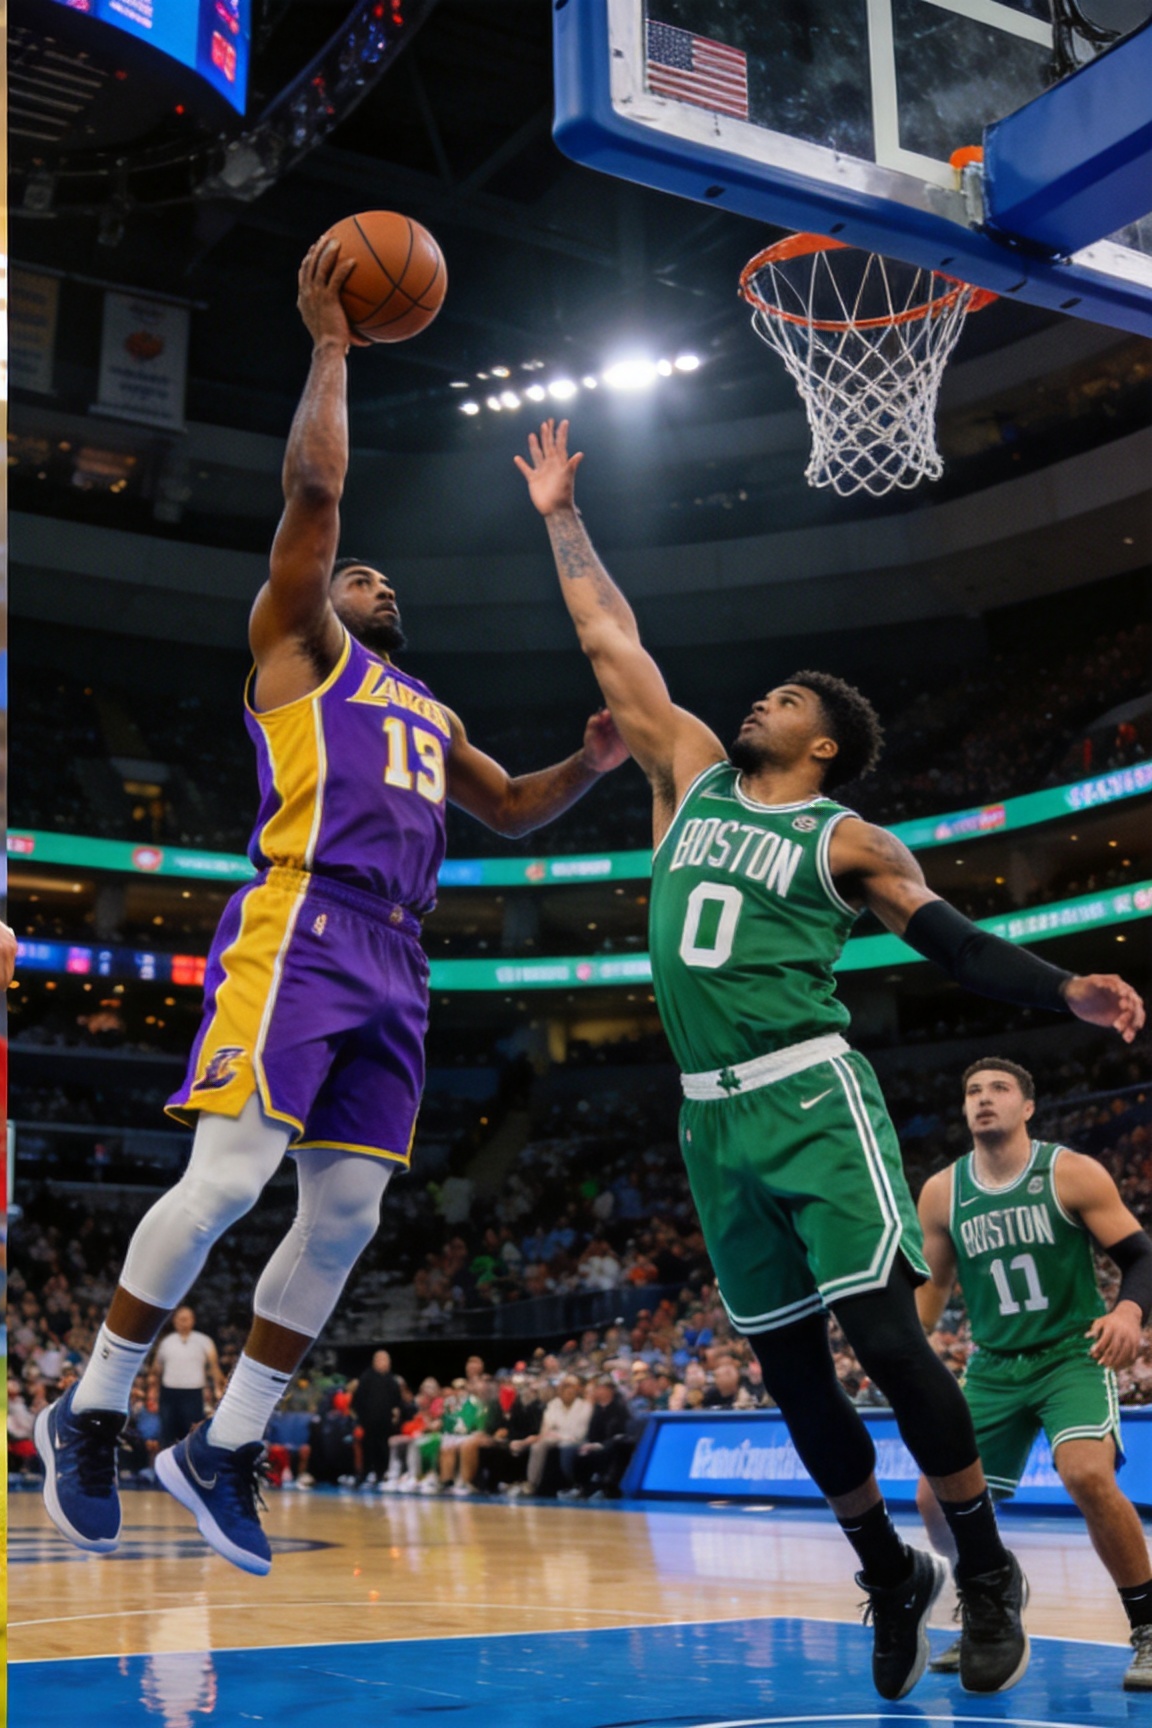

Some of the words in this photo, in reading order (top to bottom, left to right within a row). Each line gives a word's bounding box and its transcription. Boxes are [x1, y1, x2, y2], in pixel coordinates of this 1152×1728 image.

[382, 715, 446, 804] 13
[669, 817, 804, 898] BOSTON
[679, 881, 743, 968] 0
[990, 1253, 1049, 1316] 11
